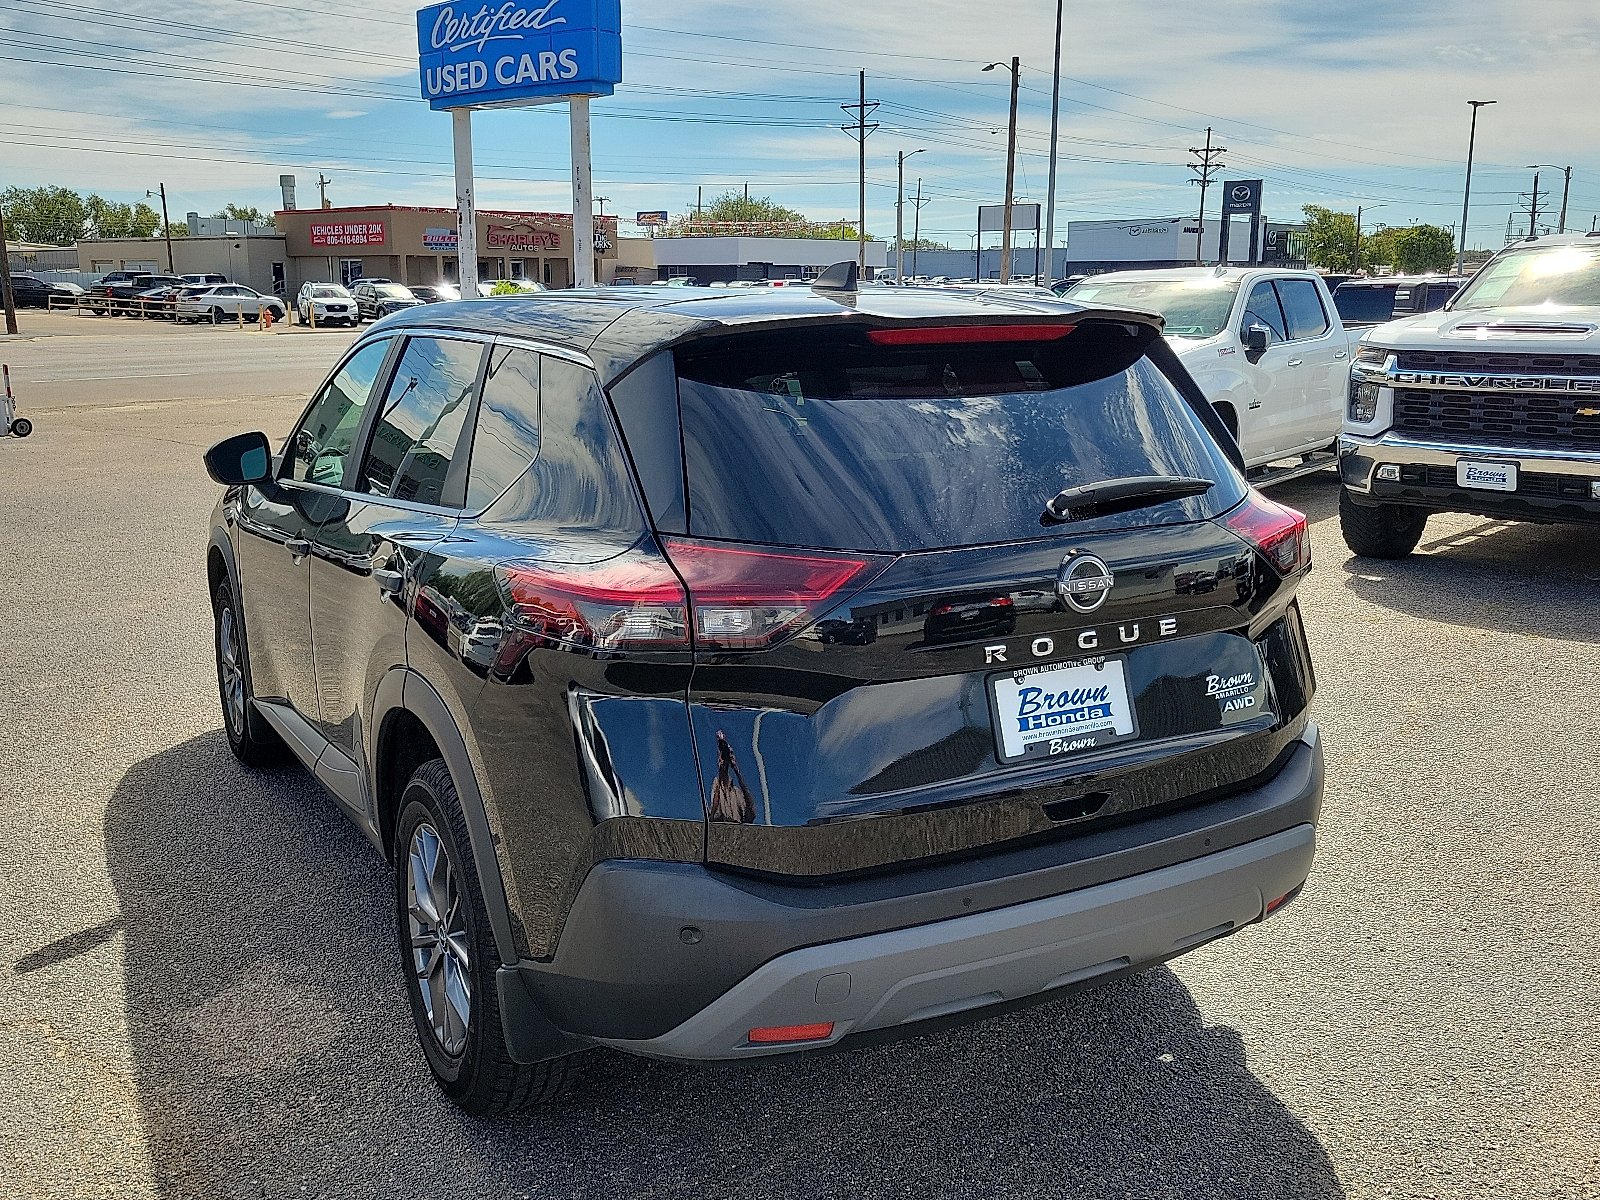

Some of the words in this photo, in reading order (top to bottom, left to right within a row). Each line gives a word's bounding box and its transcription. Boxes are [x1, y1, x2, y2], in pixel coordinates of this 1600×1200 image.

[431, 0, 567, 52] Certified
[426, 60, 488, 95] USED
[494, 49, 578, 85] CARS
[312, 225, 343, 236] VEHICLES
[344, 224, 367, 235] UNDER
[368, 223, 383, 234] 20K
[327, 235, 368, 245] 806-418-6894
[487, 233, 561, 247] CHARLEY'S
[510, 244, 540, 252] AUTOS
[594, 241, 613, 249] ORKS
[1395, 374, 1600, 391] CHEVROLE
[1466, 467, 1507, 478] Brown
[1060, 576, 1115, 594] NISSAN
[984, 618, 1178, 663] ROGUE
[1013, 667, 1039, 678] BROWN
[1040, 660, 1081, 673] AUTOMOTIVE
[1083, 656, 1106, 667] GROUP
[1206, 673, 1253, 693] Brown
[1018, 685, 1110, 717] Brown
[1215, 687, 1249, 700] AMARILLO
[1224, 696, 1255, 713] AWD
[1028, 708, 1104, 729] Honda
[1049, 737, 1097, 755] Brown
